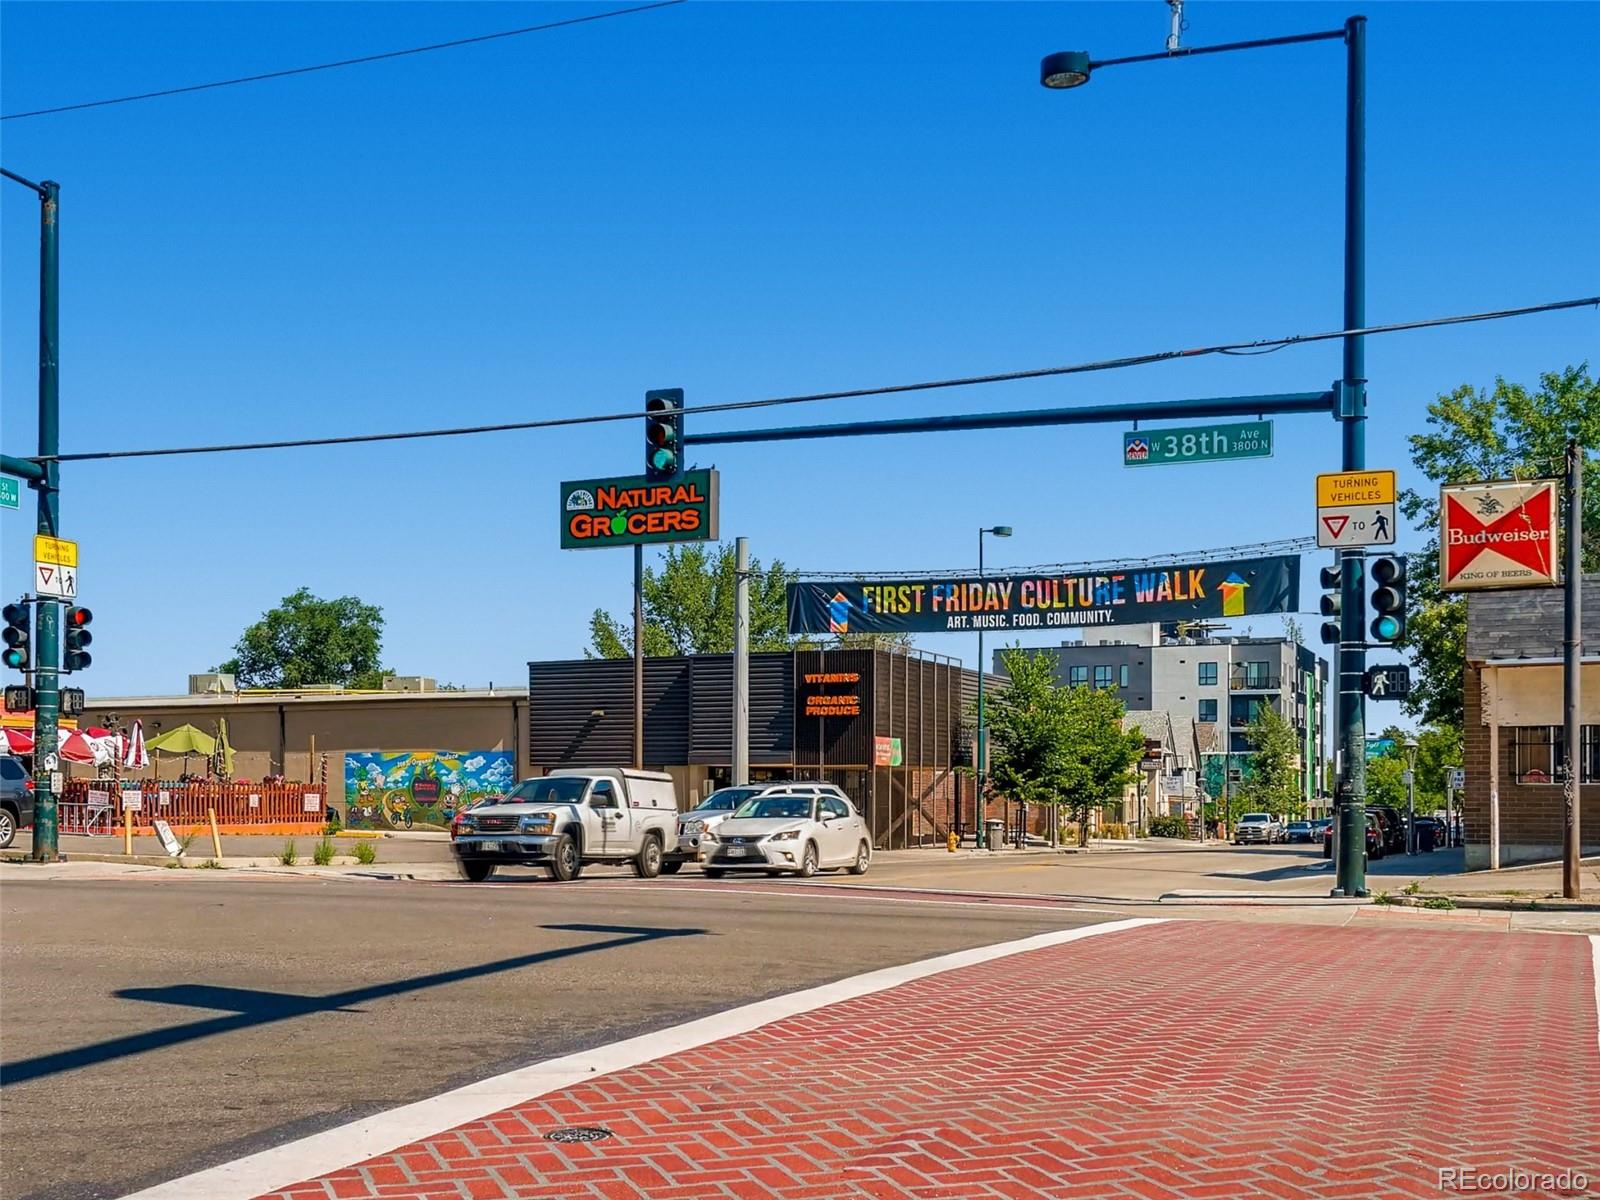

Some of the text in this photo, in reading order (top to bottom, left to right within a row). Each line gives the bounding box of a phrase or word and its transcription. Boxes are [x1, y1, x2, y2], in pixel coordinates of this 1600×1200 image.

[1240, 429, 1259, 439] Ave
[1151, 431, 1228, 457] W 38th
[1232, 439, 1268, 451] 3800 N
[1333, 478, 1378, 489] TURNING
[1330, 491, 1381, 502] VEHICLES
[1352, 521, 1366, 530] TO
[1448, 528, 1550, 545] Budweiser
[45, 542, 70, 552] TURNING
[43, 552, 71, 563] VEHICLES
[1460, 569, 1532, 580] KING OF BEERS
[862, 568, 1206, 614] FIRST FRIDAY CULTURE WALK
[947, 609, 1115, 629] ART. MUSIC. FOOD. COMMUNITY.
[804, 673, 861, 684] VITAMINS
[807, 695, 860, 706] ORGANIC
[806, 706, 860, 716] PRODUCE
